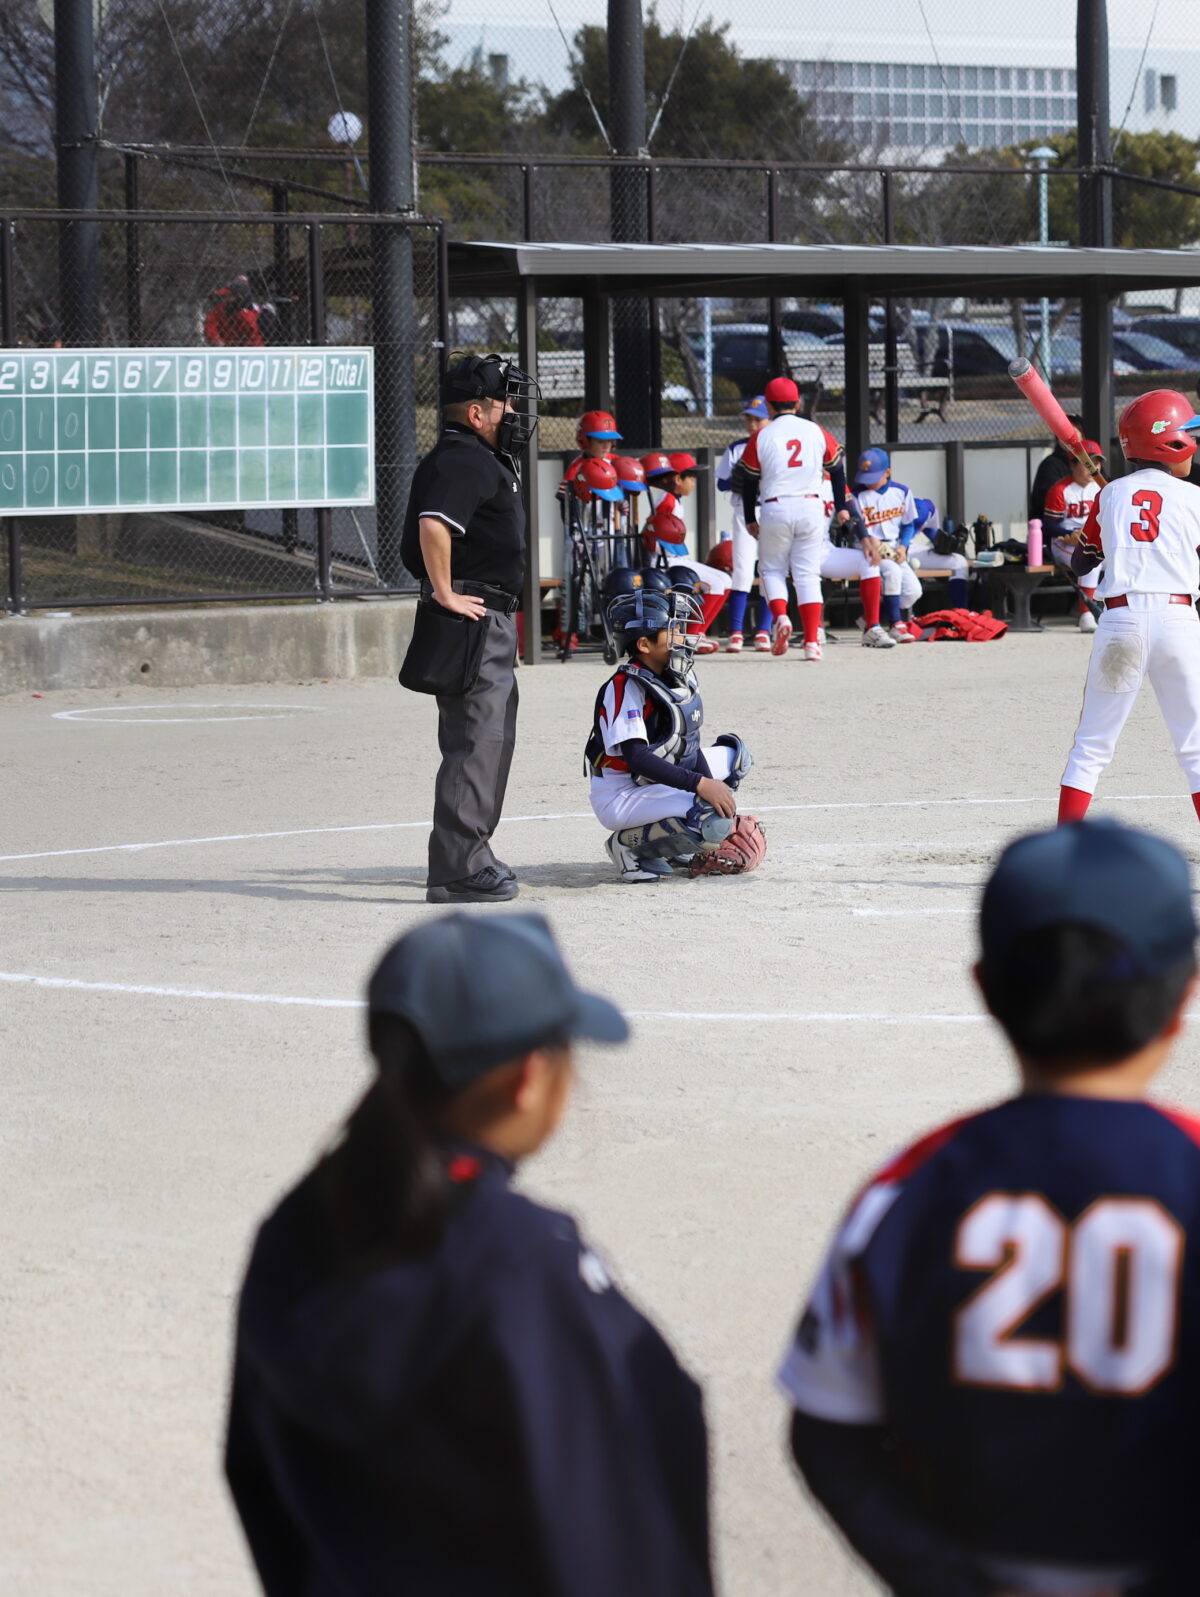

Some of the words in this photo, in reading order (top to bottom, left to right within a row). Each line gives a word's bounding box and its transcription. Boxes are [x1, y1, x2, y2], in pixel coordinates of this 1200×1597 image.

[0, 361, 19, 390] 2
[30, 361, 50, 389] 3
[61, 360, 81, 389] 4
[91, 361, 112, 389] 5
[123, 361, 143, 388] 6
[152, 360, 172, 388] 7
[184, 360, 202, 388] 8
[213, 359, 232, 388] 9
[240, 359, 265, 388] 10
[271, 359, 292, 387] 11
[299, 359, 322, 387] 12
[329, 358, 364, 386] Total
[786, 439, 803, 468] 2
[1130, 489, 1163, 542] 3
[955, 1191, 1186, 1397] 20
